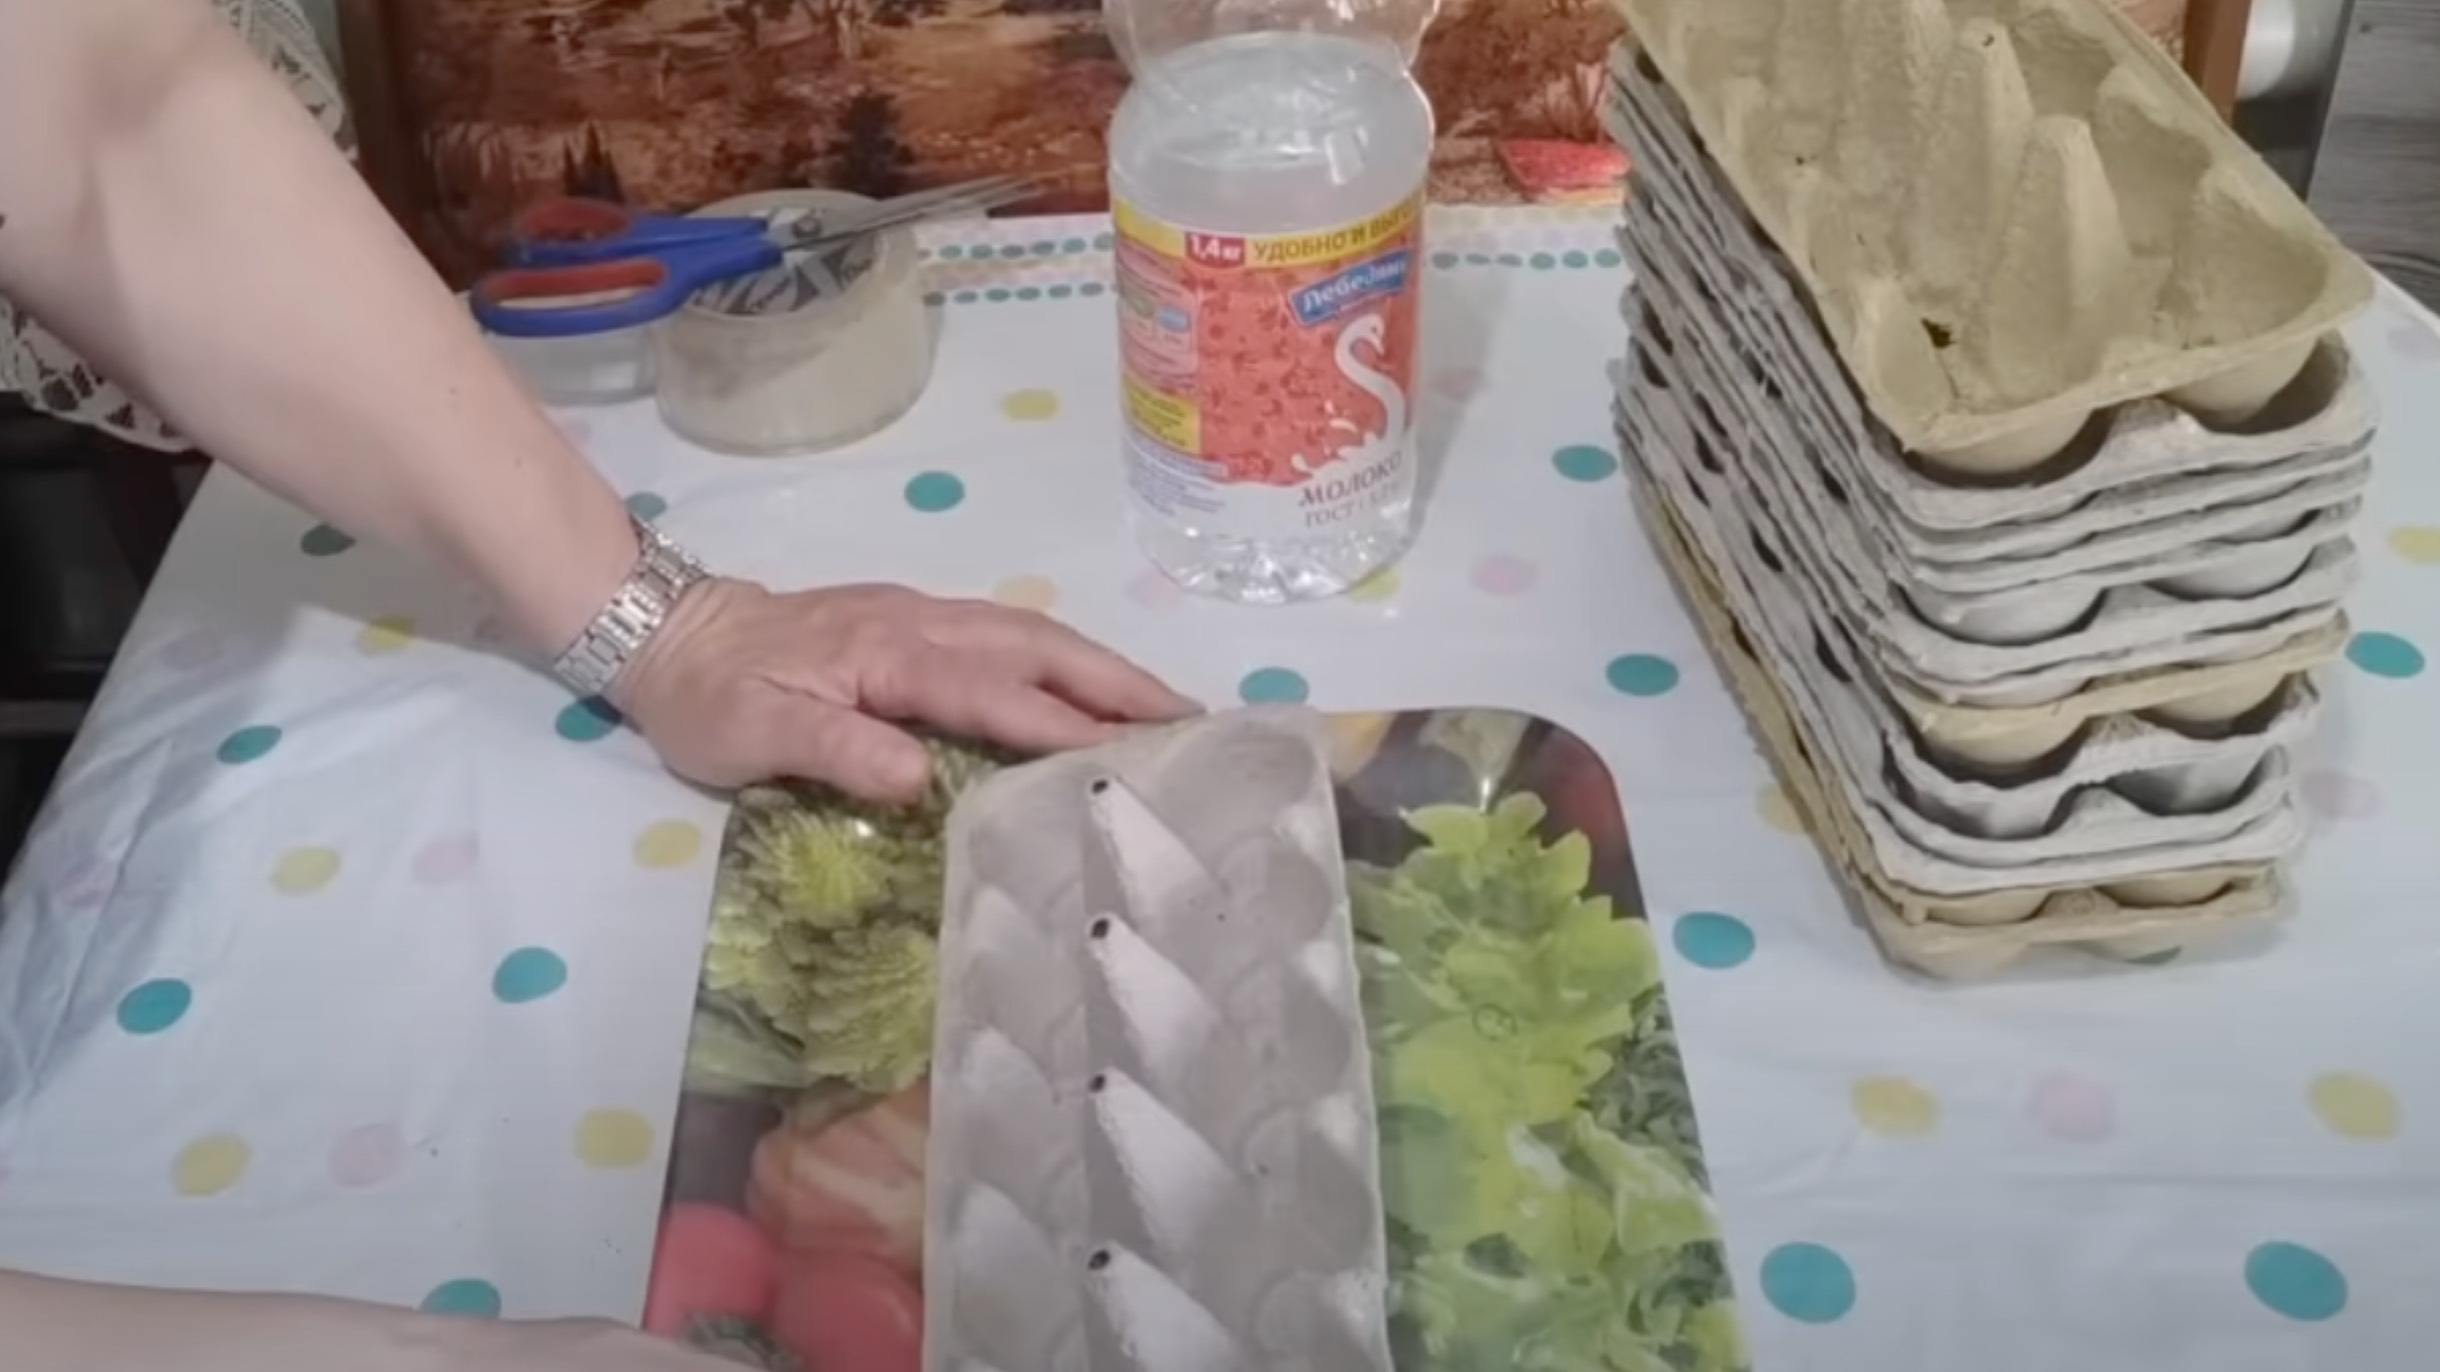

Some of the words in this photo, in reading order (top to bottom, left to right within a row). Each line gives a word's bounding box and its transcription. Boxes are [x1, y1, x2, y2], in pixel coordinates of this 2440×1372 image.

[1254, 231, 1346, 262] УДОБНО
[1351, 227, 1367, 246] И
[1298, 449, 1401, 508] МОЛОКО
[1305, 500, 1355, 529] ГОСТ
